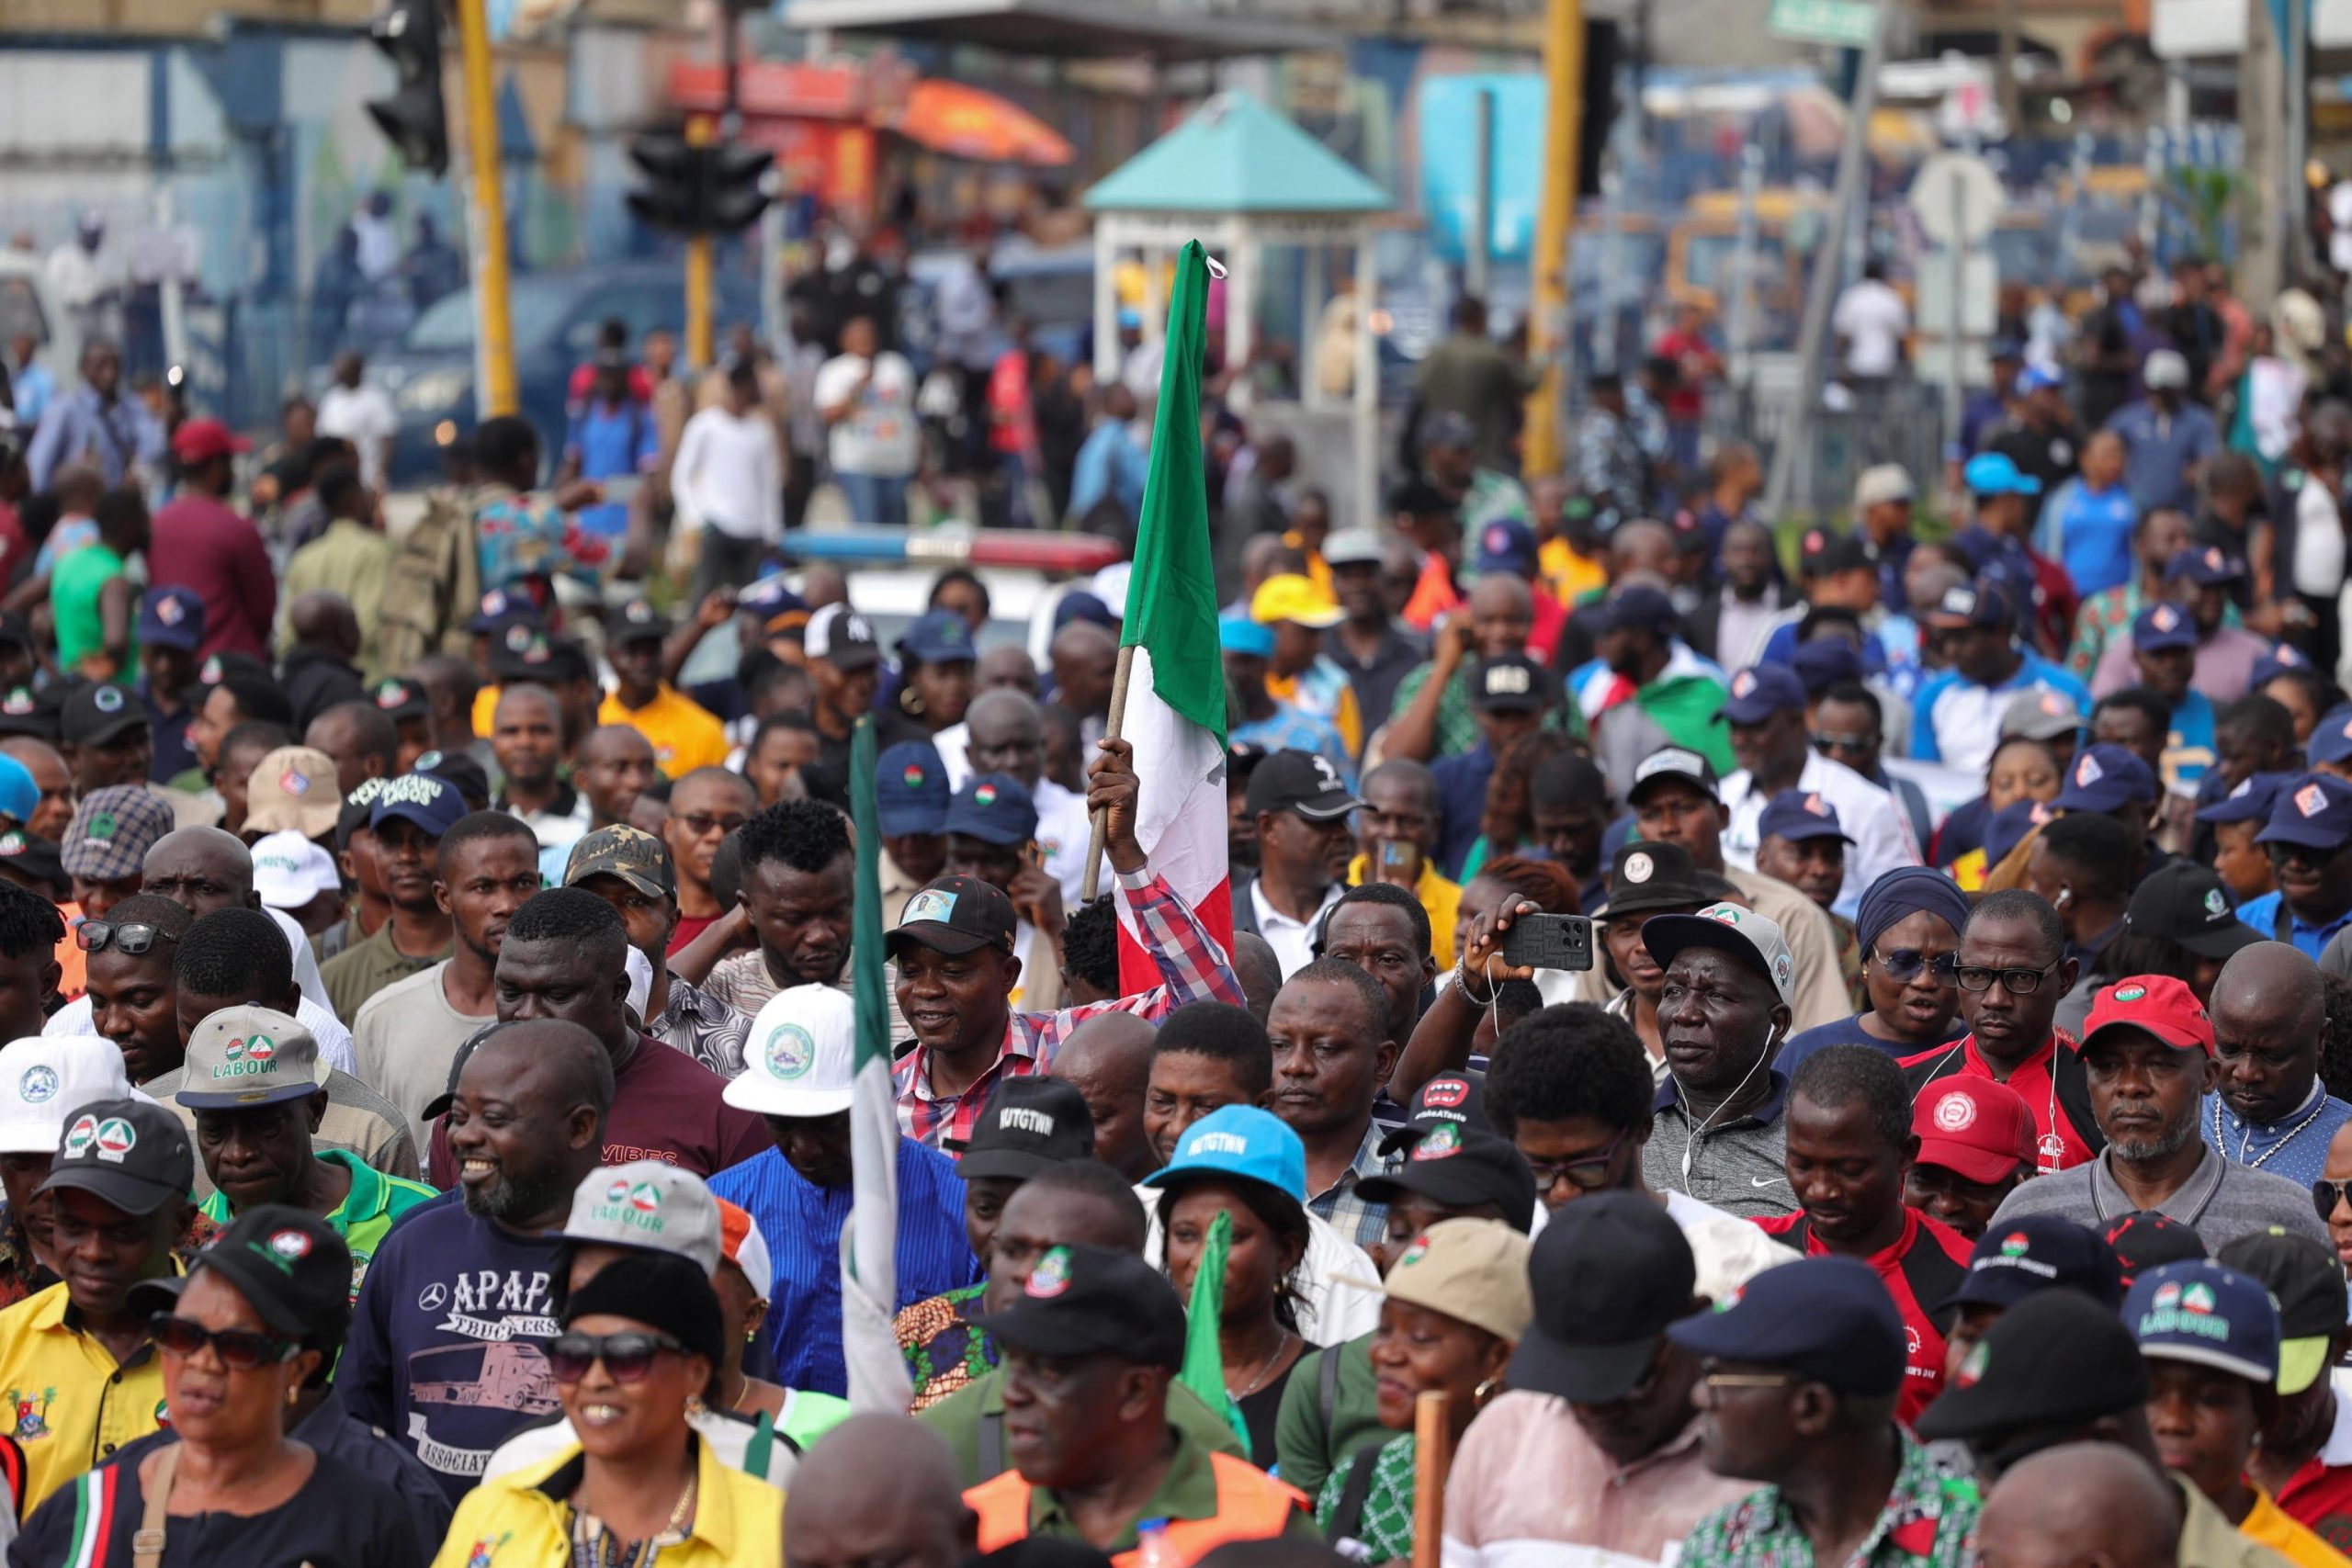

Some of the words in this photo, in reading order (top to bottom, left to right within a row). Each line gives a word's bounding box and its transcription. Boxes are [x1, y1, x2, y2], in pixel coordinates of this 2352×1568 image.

[212, 1060, 278, 1078] LABOUR
[602, 1144, 678, 1168] VIBES
[2139, 1313, 2230, 1342] LABOUR
[423, 1442, 492, 1472] ASSOCIAT
